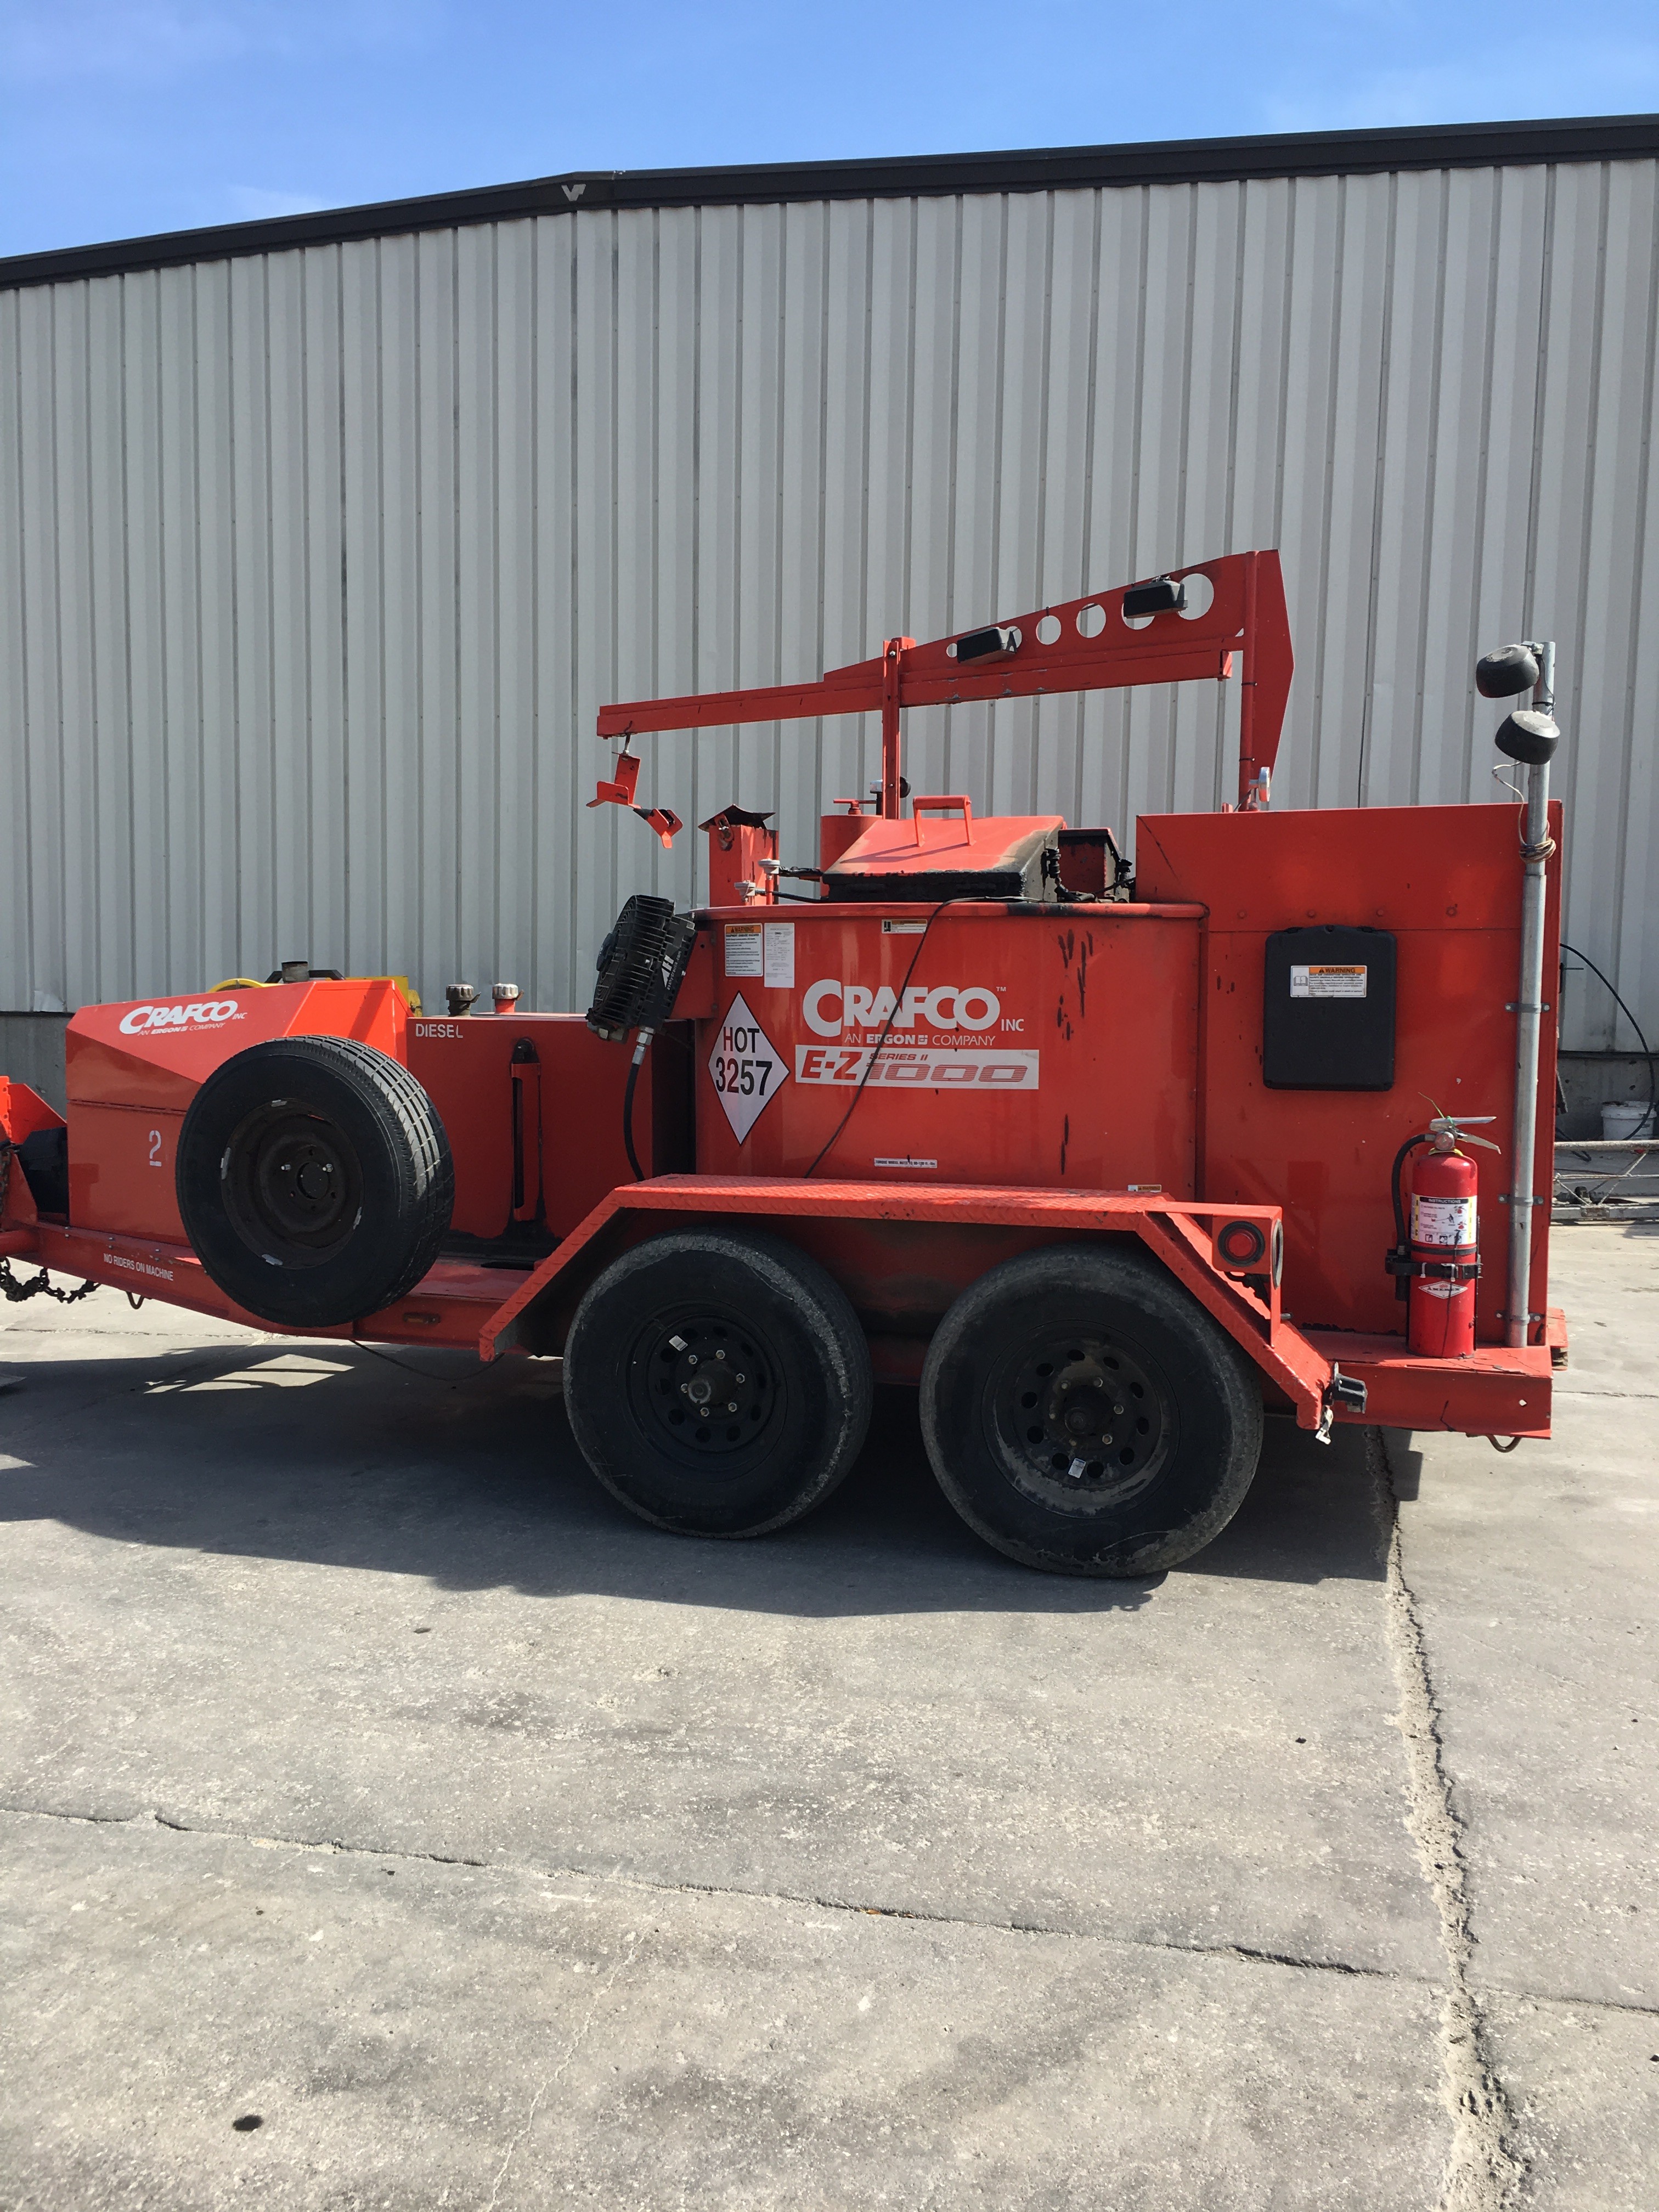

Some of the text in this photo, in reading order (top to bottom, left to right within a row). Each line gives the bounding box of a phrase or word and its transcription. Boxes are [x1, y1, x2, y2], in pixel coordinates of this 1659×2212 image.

[119, 1000, 238, 1034] CRAFCO
[803, 979, 1000, 1037] CRAFCO
[1001, 1019, 1024, 1031] INC
[189, 1022, 225, 1031] COMPANY
[416, 1023, 464, 1039] DIESEL
[723, 1026, 760, 1053] HOT
[844, 1033, 996, 1046] AN ERGON COMPANY
[800, 1049, 1028, 1082] E-Z 1000
[870, 1053, 916, 1061] SERIES
[715, 1057, 772, 1096] 3257
[149, 1130, 162, 1167] 2
[103, 1253, 174, 1282] NO RIDERS ON MACHINE
